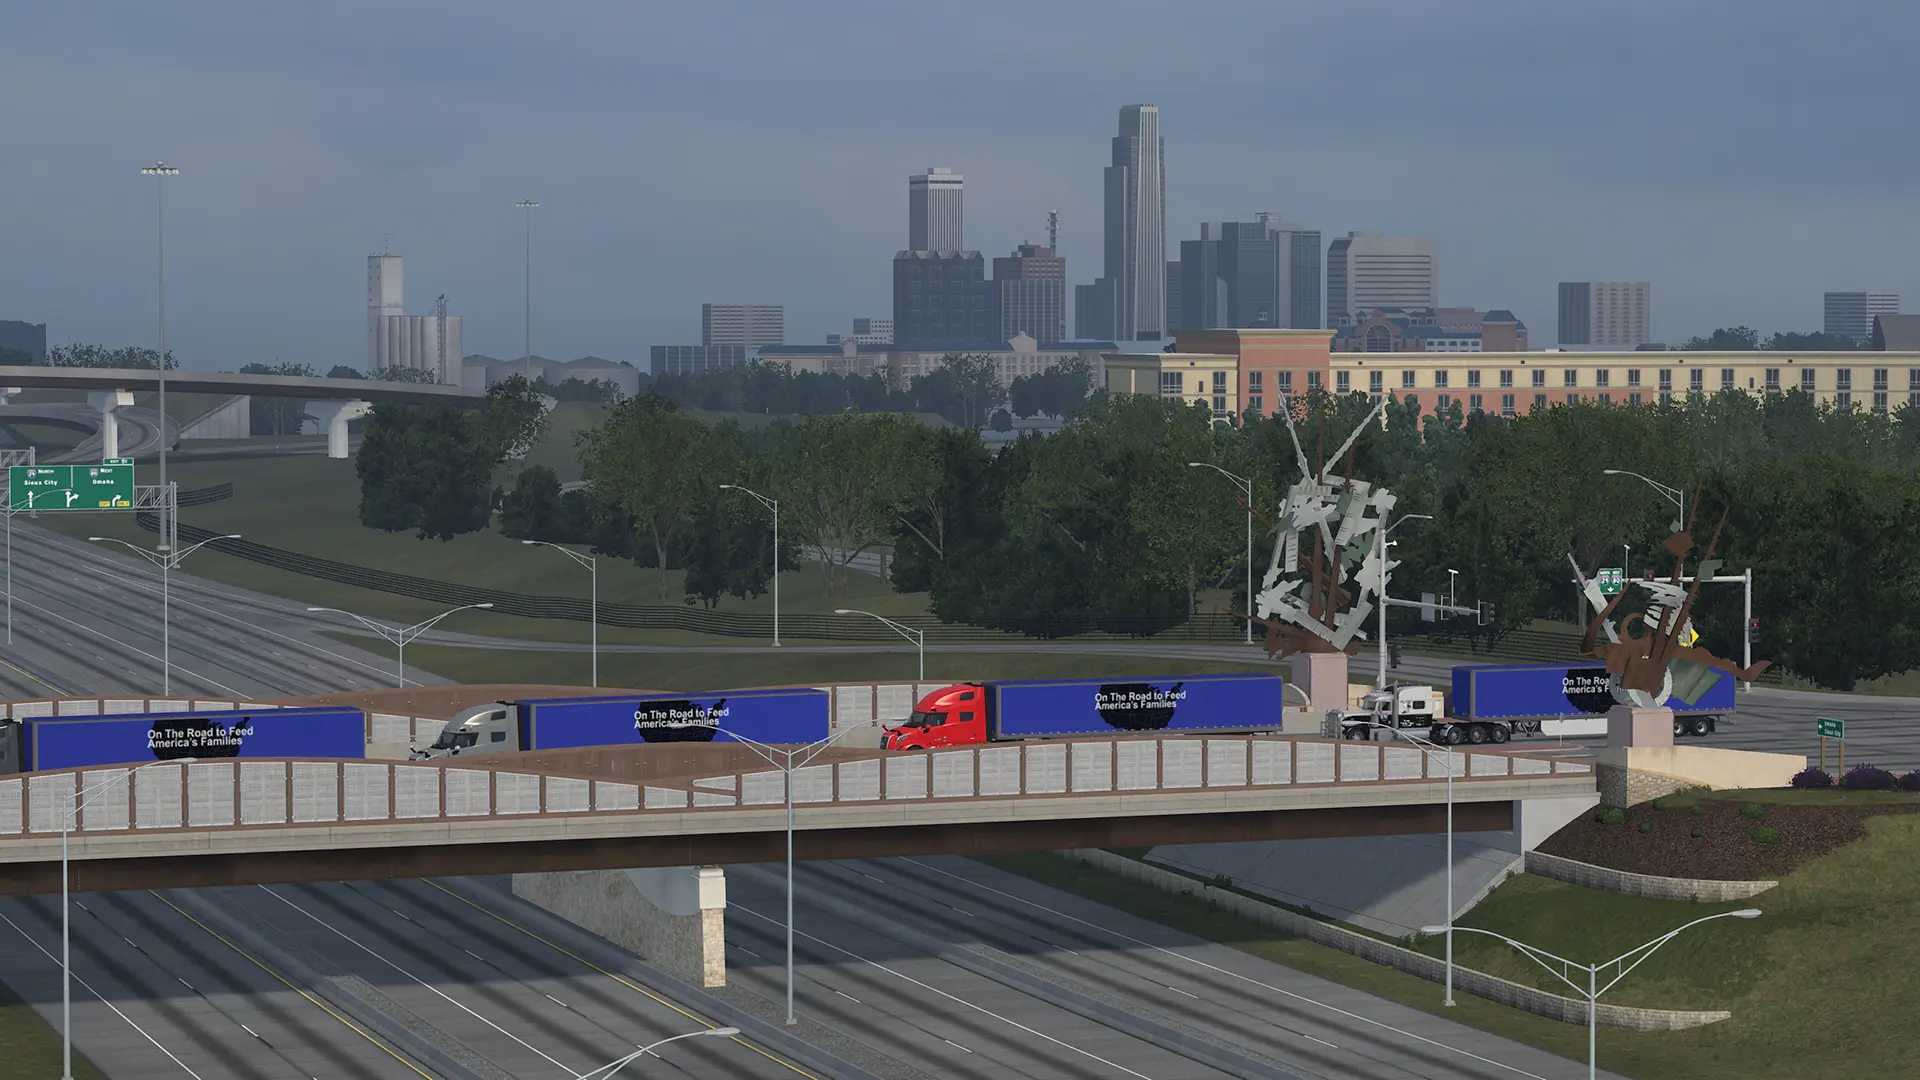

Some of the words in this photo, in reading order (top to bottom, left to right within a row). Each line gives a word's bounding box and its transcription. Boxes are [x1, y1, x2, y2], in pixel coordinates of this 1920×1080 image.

[1562, 677, 1574, 686] On
[1576, 677, 1591, 686] The
[1594, 676, 1609, 685] Roa
[1562, 684, 1602, 694] America's
[1095, 693, 1108, 702] On
[1110, 693, 1126, 701] The
[1129, 692, 1151, 700] Road
[1154, 691, 1162, 699] to
[1165, 690, 1186, 699] Feed
[1095, 701, 1138, 710] America's
[1141, 700, 1177, 708] Families
[634, 711, 647, 720] On
[650, 710, 667, 718] The
[670, 709, 693, 718] Road
[696, 709, 705, 717] to
[708, 707, 729, 716] Feed
[148, 730, 162, 739] On
[165, 728, 184, 738] The
[187, 728, 213, 737] Road
[216, 727, 226, 736] to
[229, 726, 254, 736] Feed
[148, 739, 197, 748] America's
[201, 736, 243, 746] Families
